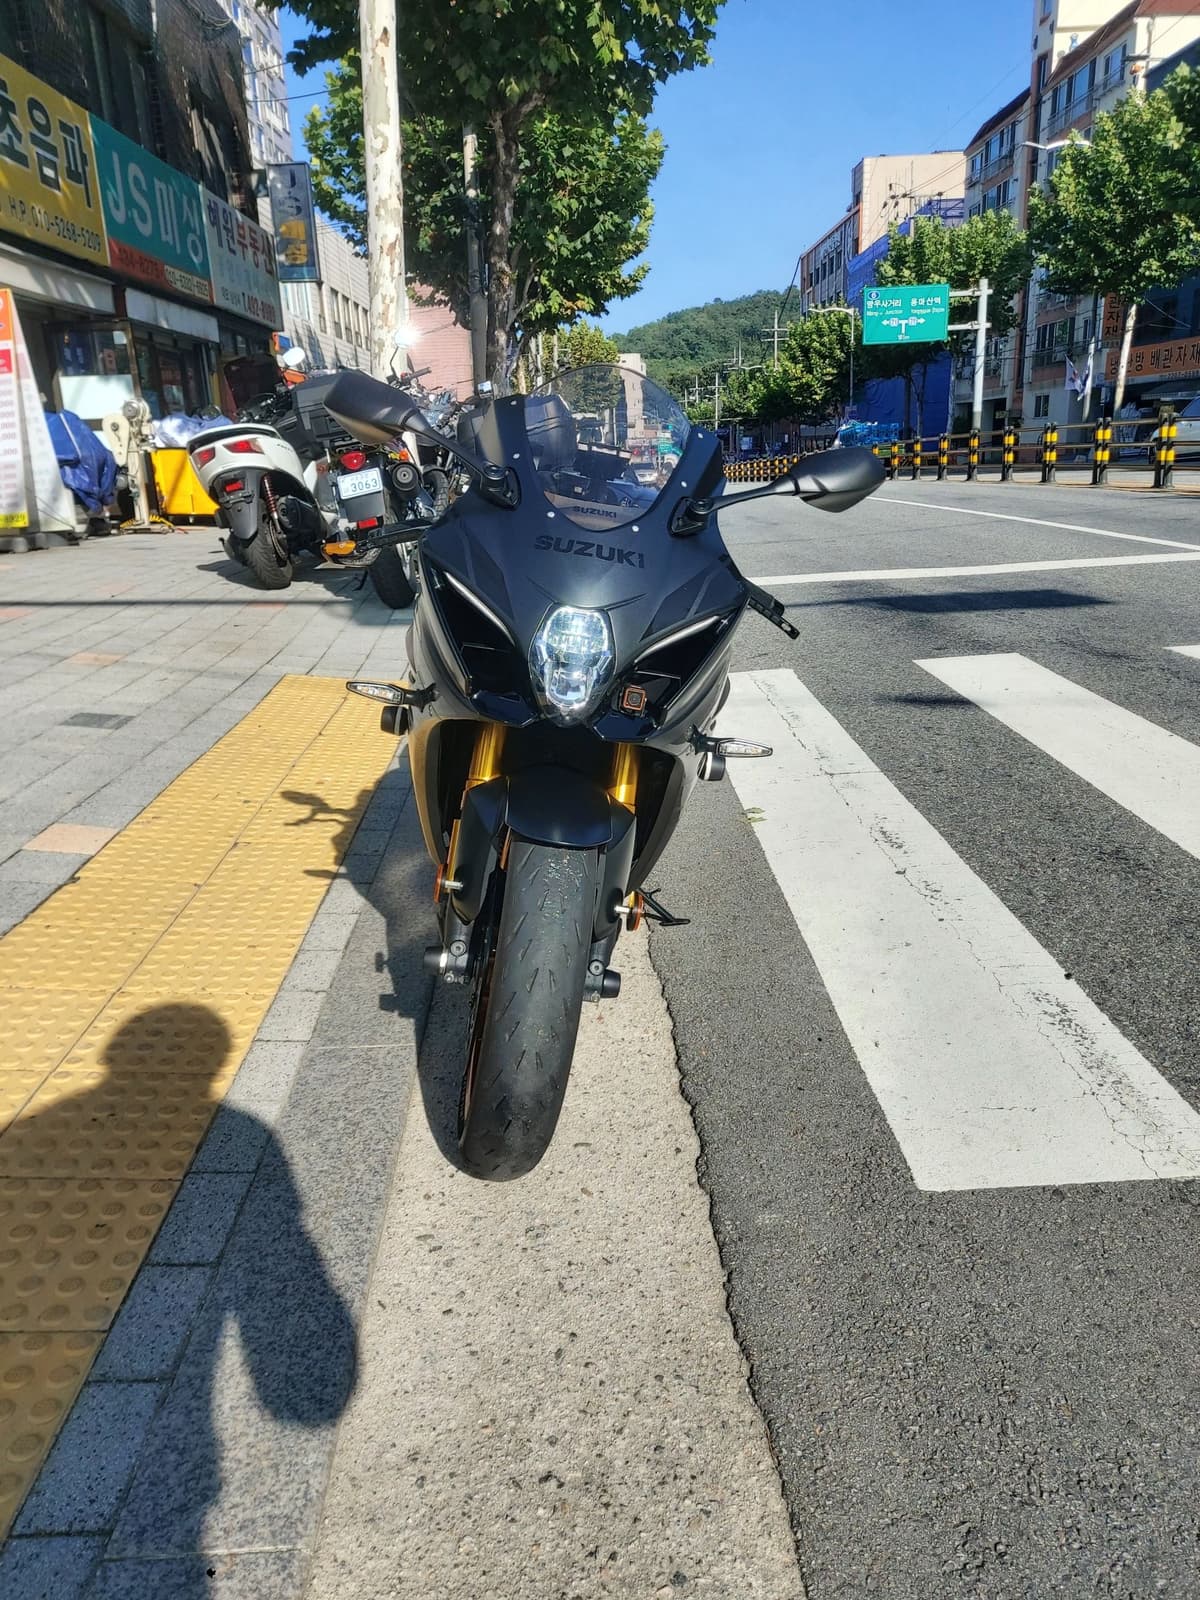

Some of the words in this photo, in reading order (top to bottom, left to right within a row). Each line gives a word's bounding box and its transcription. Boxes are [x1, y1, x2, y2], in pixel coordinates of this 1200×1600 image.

[351, 478, 378, 493] 3063
[573, 505, 617, 519] SUZUKI
[534, 535, 645, 569] SUZUKI
